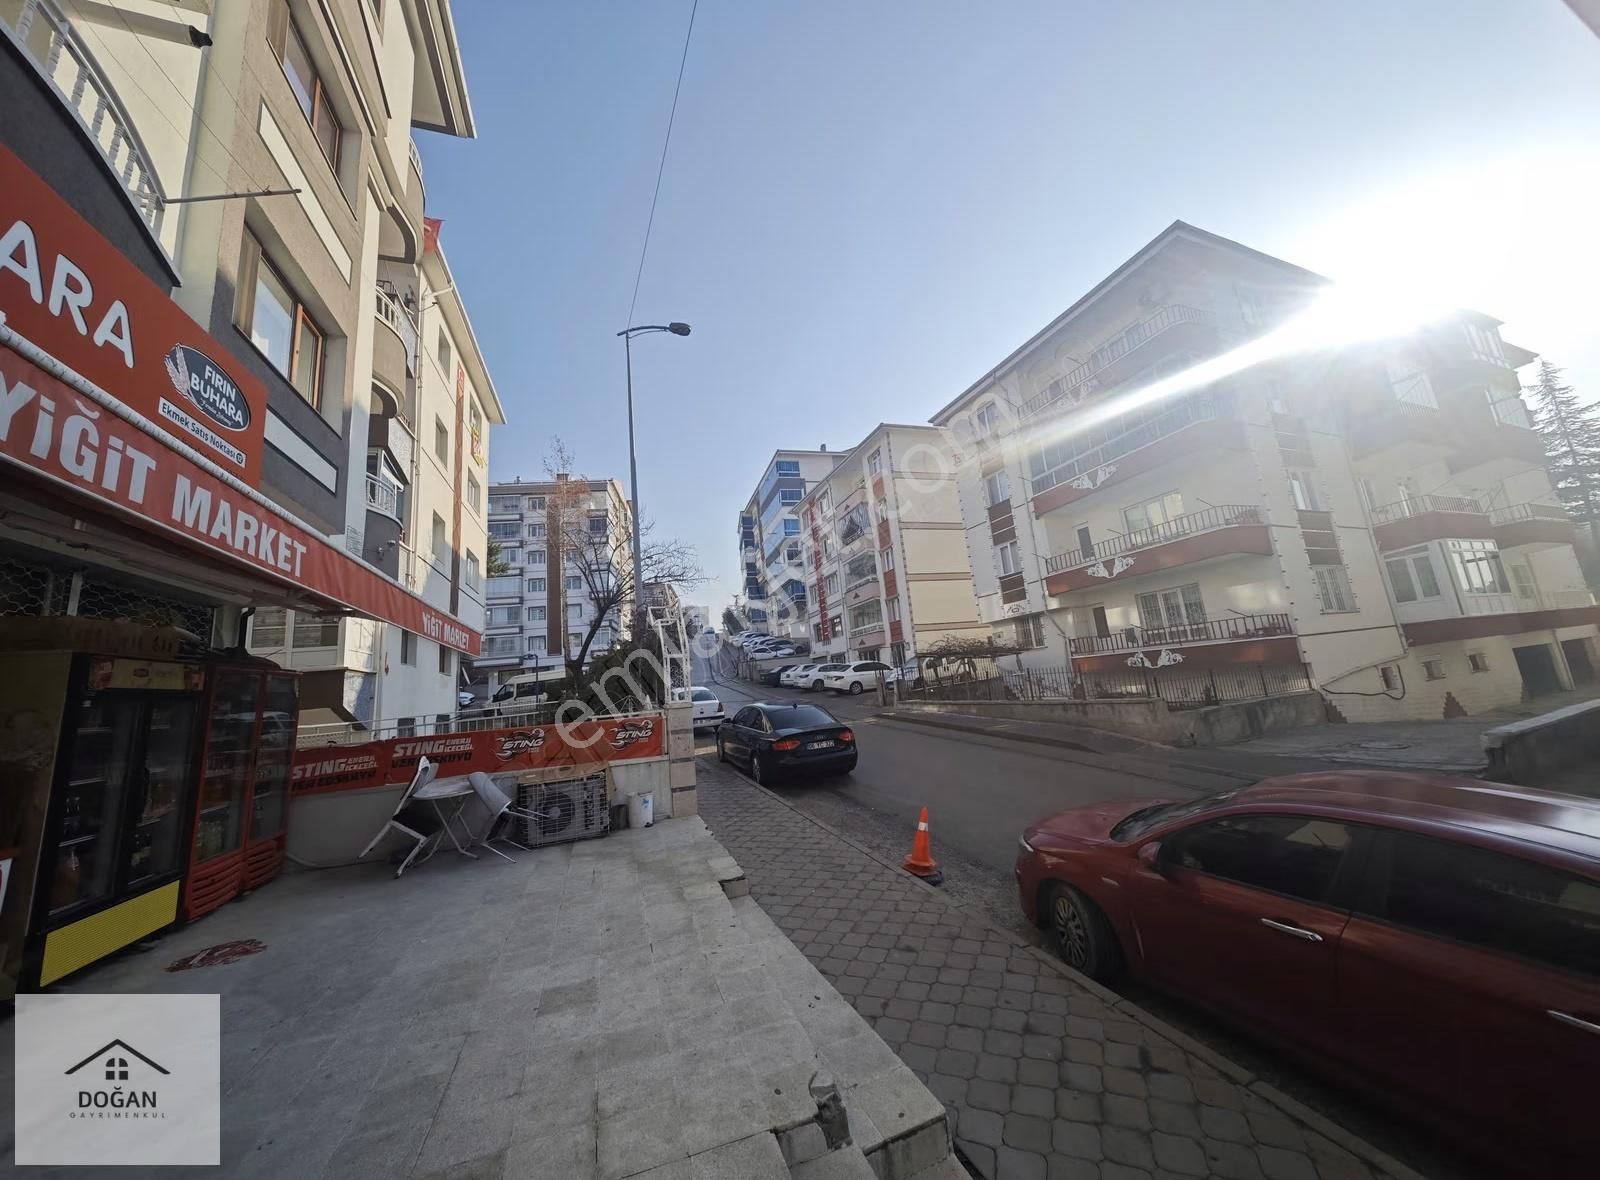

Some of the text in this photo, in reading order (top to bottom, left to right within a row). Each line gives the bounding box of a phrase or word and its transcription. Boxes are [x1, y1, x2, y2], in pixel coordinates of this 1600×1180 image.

[0, 220, 135, 369] ARA
[190, 372, 244, 426] BUHARA
[204, 365, 236, 402] FIRIN
[161, 401, 190, 430] Ekmek
[190, 420, 209, 443] Satış
[209, 434, 236, 459] Noktası
[171, 474, 308, 578] MARKET
[391, 739, 446, 758] STING
[502, 737, 545, 750] STING
[615, 729, 653, 740] STING
[291, 758, 348, 780] STING
